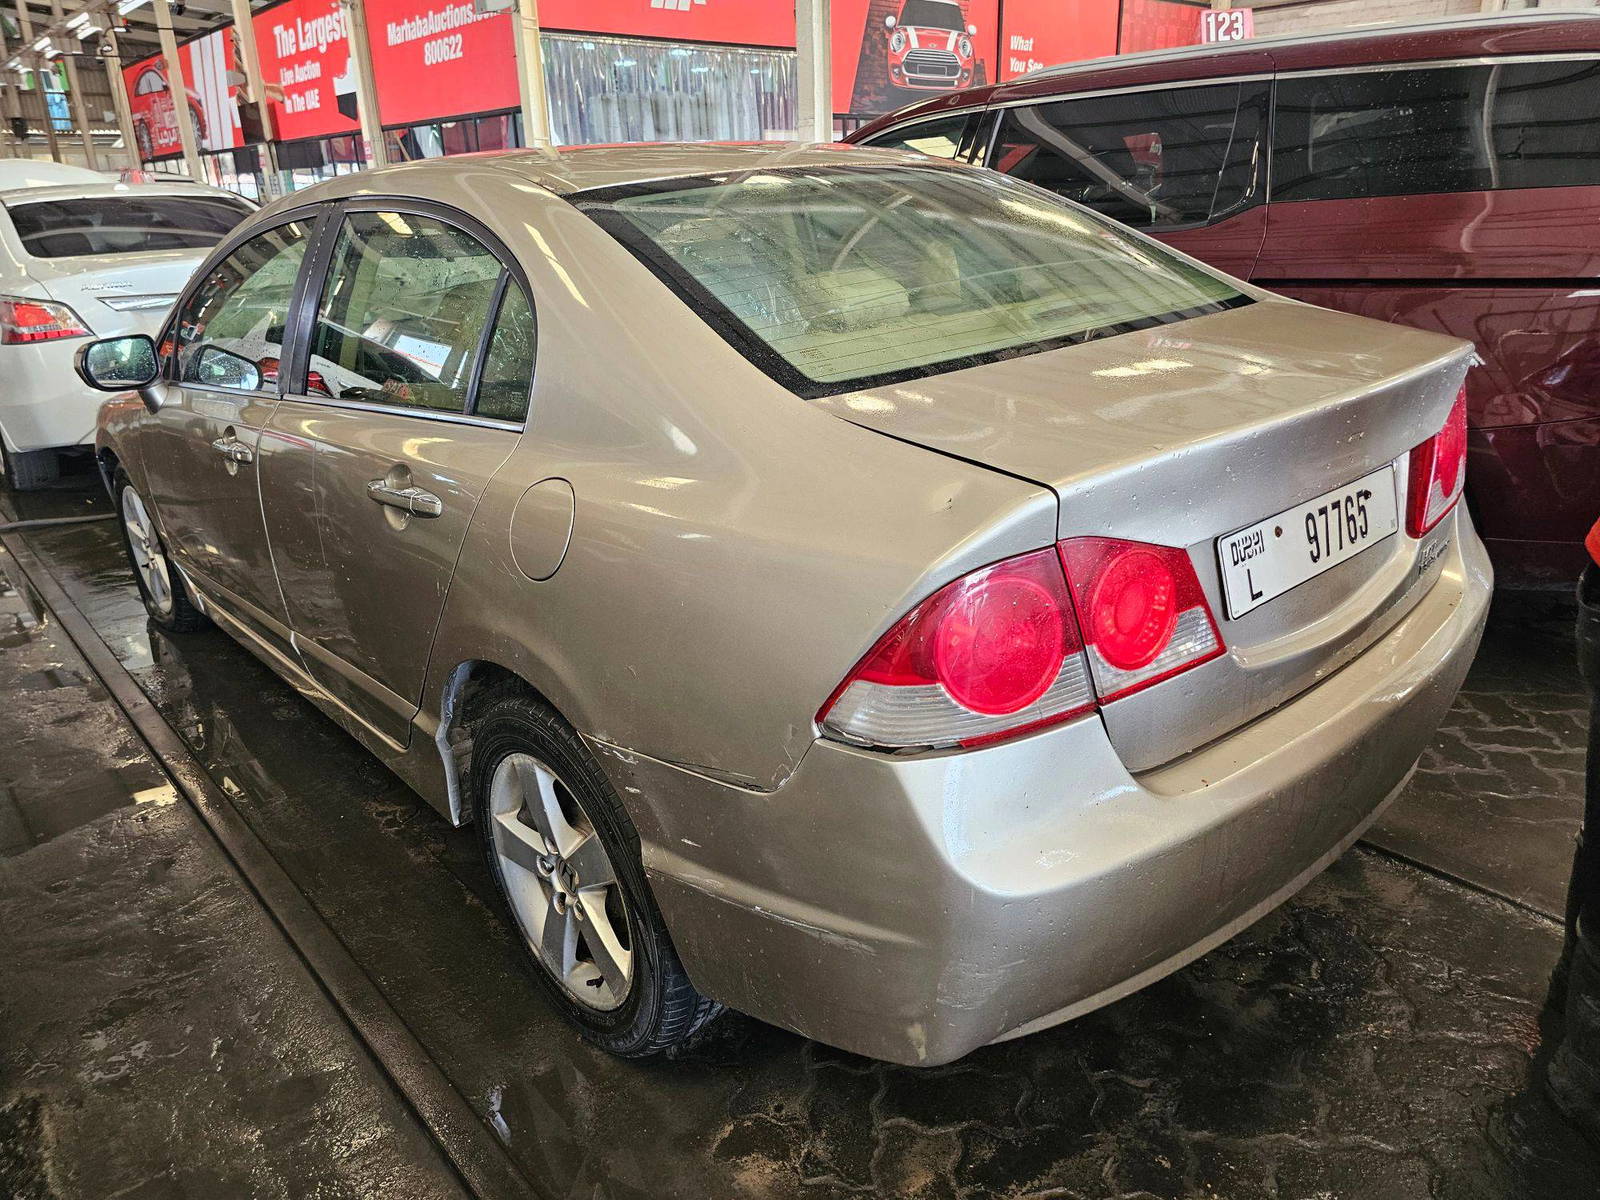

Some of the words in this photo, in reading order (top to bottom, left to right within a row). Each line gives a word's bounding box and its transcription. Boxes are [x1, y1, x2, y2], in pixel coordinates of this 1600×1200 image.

[273, 24, 297, 59] The
[296, 7, 347, 53] Largest
[1207, 11, 1243, 42] 123
[424, 33, 463, 66] 800622
[1010, 35, 1034, 51] What
[280, 67, 295, 87] Live
[294, 60, 321, 82] Auction
[1010, 57, 1026, 72] You
[291, 94, 306, 112] The
[304, 88, 320, 110] UAE
[1304, 489, 1370, 563] 97765
[1246, 568, 1263, 601] L
